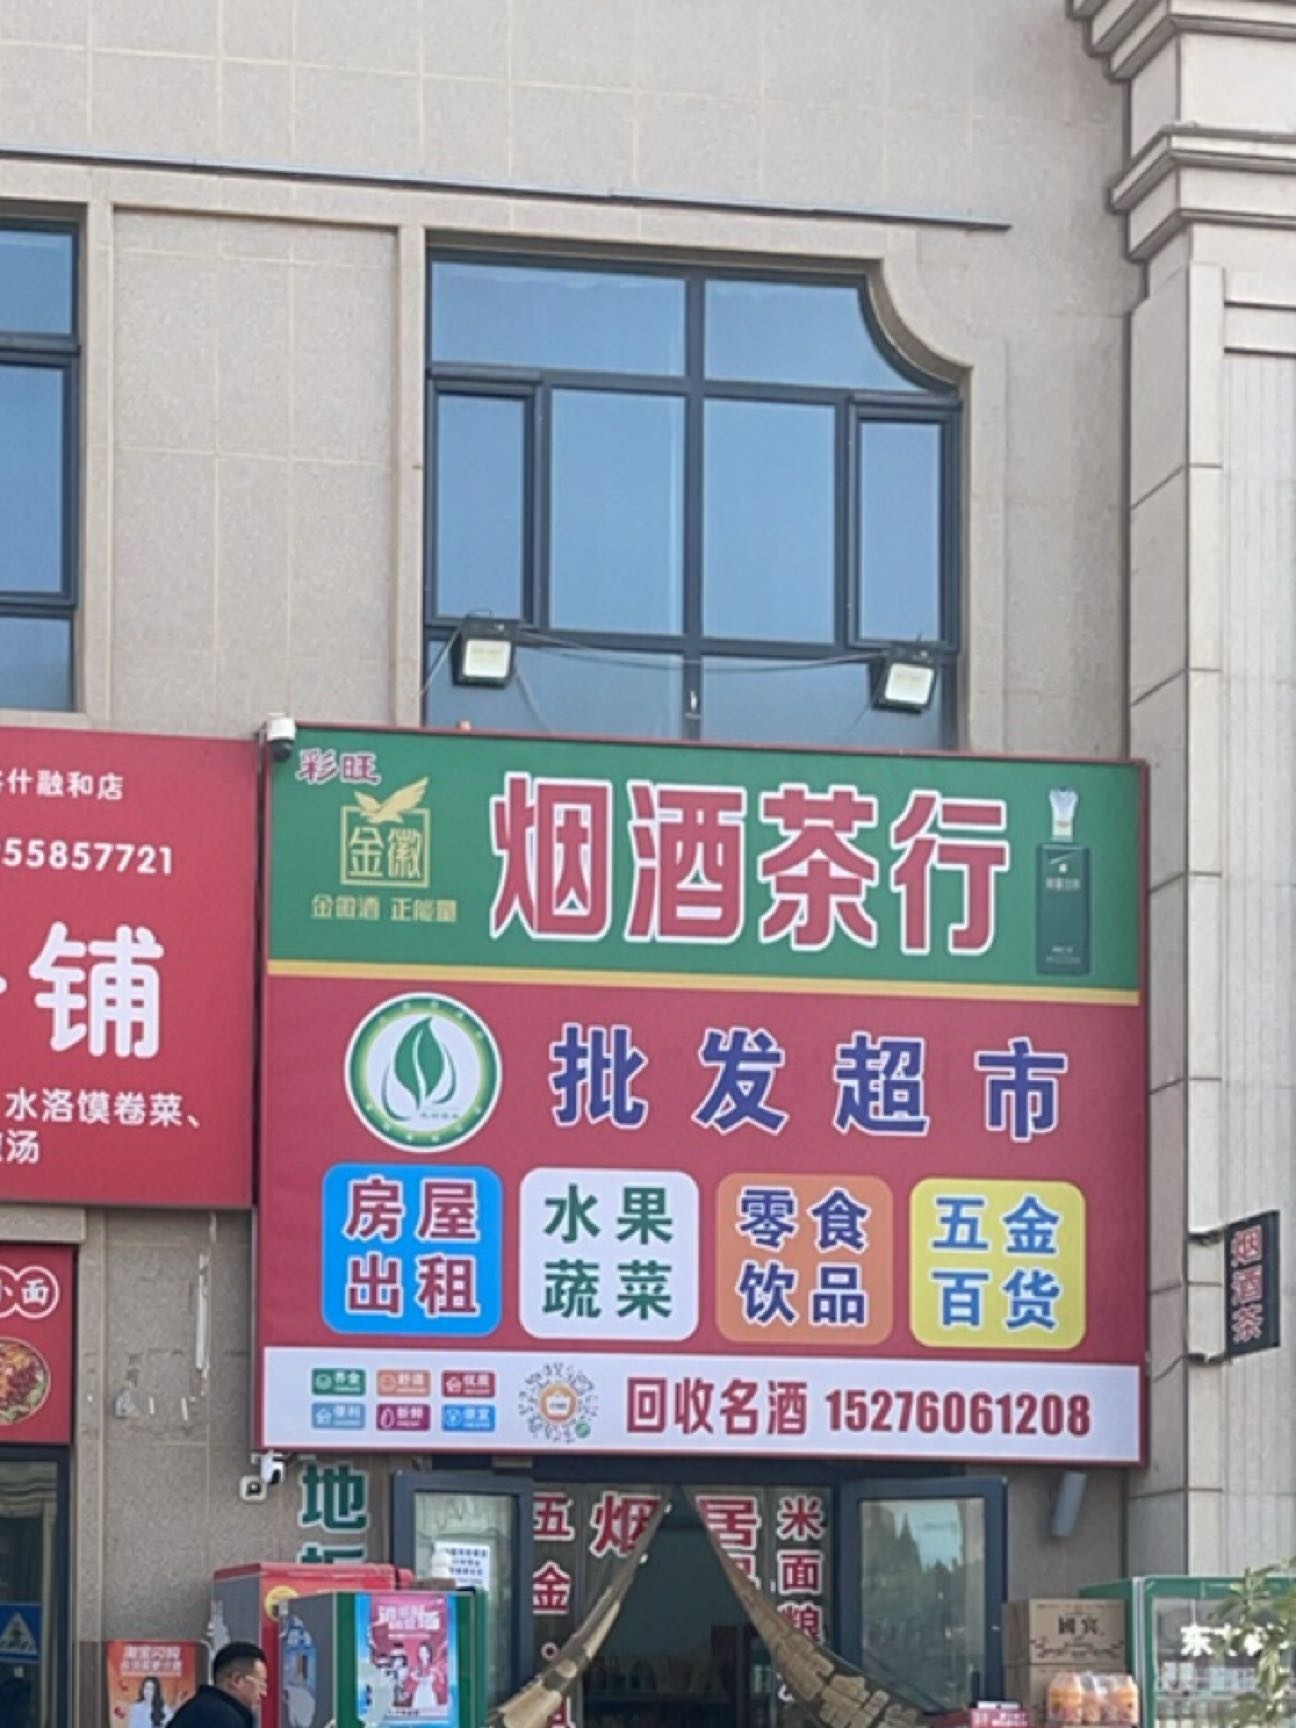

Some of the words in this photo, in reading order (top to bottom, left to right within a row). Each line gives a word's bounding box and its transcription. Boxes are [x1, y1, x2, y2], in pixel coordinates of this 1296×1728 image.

[297, 748, 381, 786] 彩旺
[348, 826, 423, 880] 金徽
[490, 771, 1009, 955] 烟酒茶行
[549, 1022, 1068, 1143] 批发超市
[343, 1176, 480, 1242] 房屋
[543, 1183, 673, 1245] 水果
[738, 1187, 869, 1253] 零食
[930, 1194, 1062, 1257] 五金
[345, 1252, 480, 1318] 出租
[542, 1258, 672, 1320] 蔬菜
[738, 1261, 869, 1328] 饮品
[930, 1267, 1062, 1332] 百货
[626, 1375, 809, 1436] 回收名酒
[826, 1388, 1091, 1438] 15276061208
